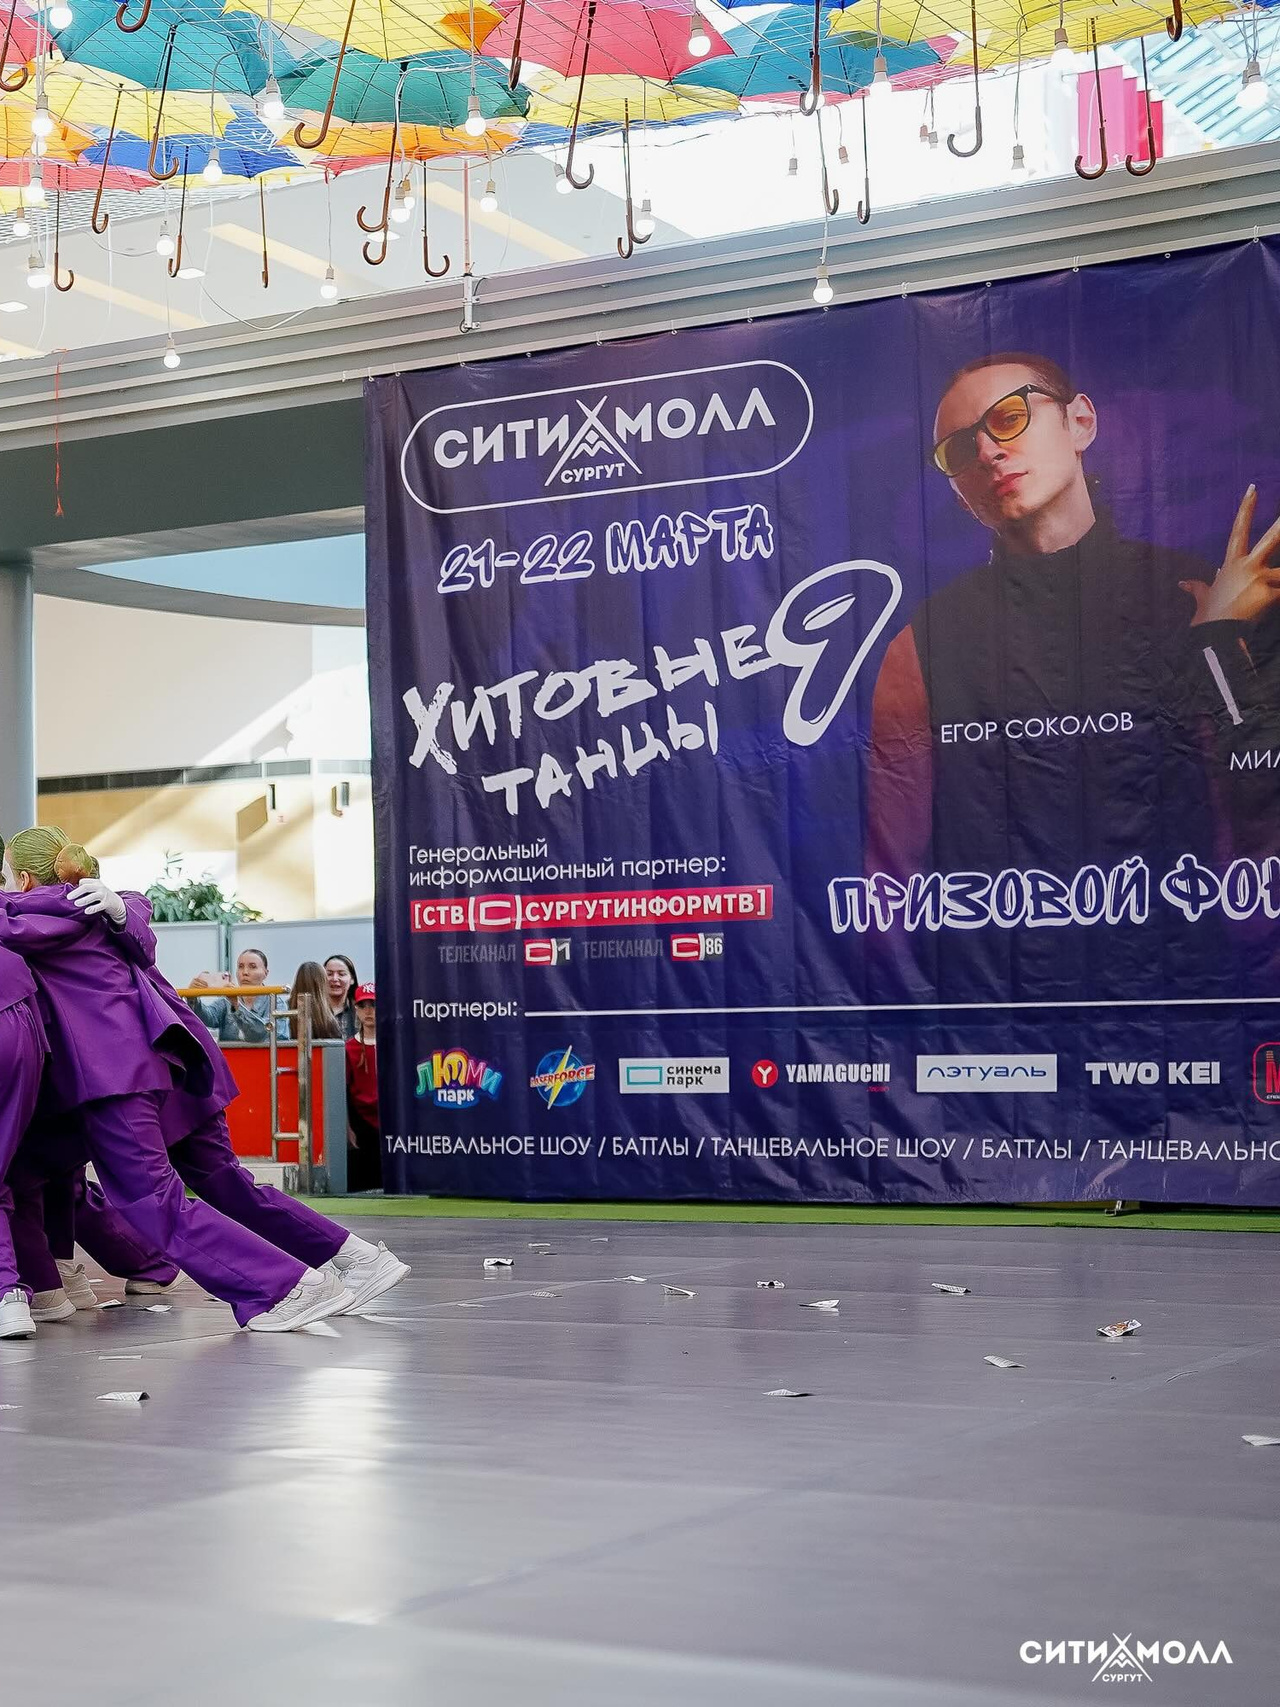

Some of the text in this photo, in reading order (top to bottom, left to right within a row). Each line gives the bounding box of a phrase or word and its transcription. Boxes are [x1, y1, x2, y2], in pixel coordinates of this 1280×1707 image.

[434, 386, 777, 470] СИТИ МОЛЛ
[560, 462, 626, 485] СУРГУТ
[437, 504, 776, 594] 21-22 МАРТА
[402, 623, 773, 776] ХИТОВЫЕ
[940, 712, 1134, 744] ЕГОР СОКОЛОВ
[481, 701, 720, 816] ТАНЦЫ
[409, 837, 548, 867] Генеральный
[409, 855, 726, 889] информационный партнер:
[828, 855, 1150, 934] ПРИЗОВОЙ
[438, 943, 516, 964] ТЕЛЕКАНАЛ
[582, 938, 664, 959] ТЕЛЕКАНАЛ
[413, 1000, 517, 1022] Партнеры:
[667, 1065, 721, 1075] синема
[667, 1075, 704, 1089] парк
[785, 1063, 890, 1083] YAMAGUCHI
[1085, 1061, 1220, 1084] TWO KEI
[437, 1088, 475, 1106] парк
[385, 1135, 535, 1155] ТАНЦЕВАЛЬНОЕ
[540, 1137, 591, 1155] ШОУ
[612, 1136, 689, 1156] БАТТЛЫ
[711, 1137, 889, 1158] ТАНЦЕВАЛЬНОЕ
[896, 1138, 956, 1158] ШОУ
[981, 1139, 1071, 1159] БАТТЛЫ
